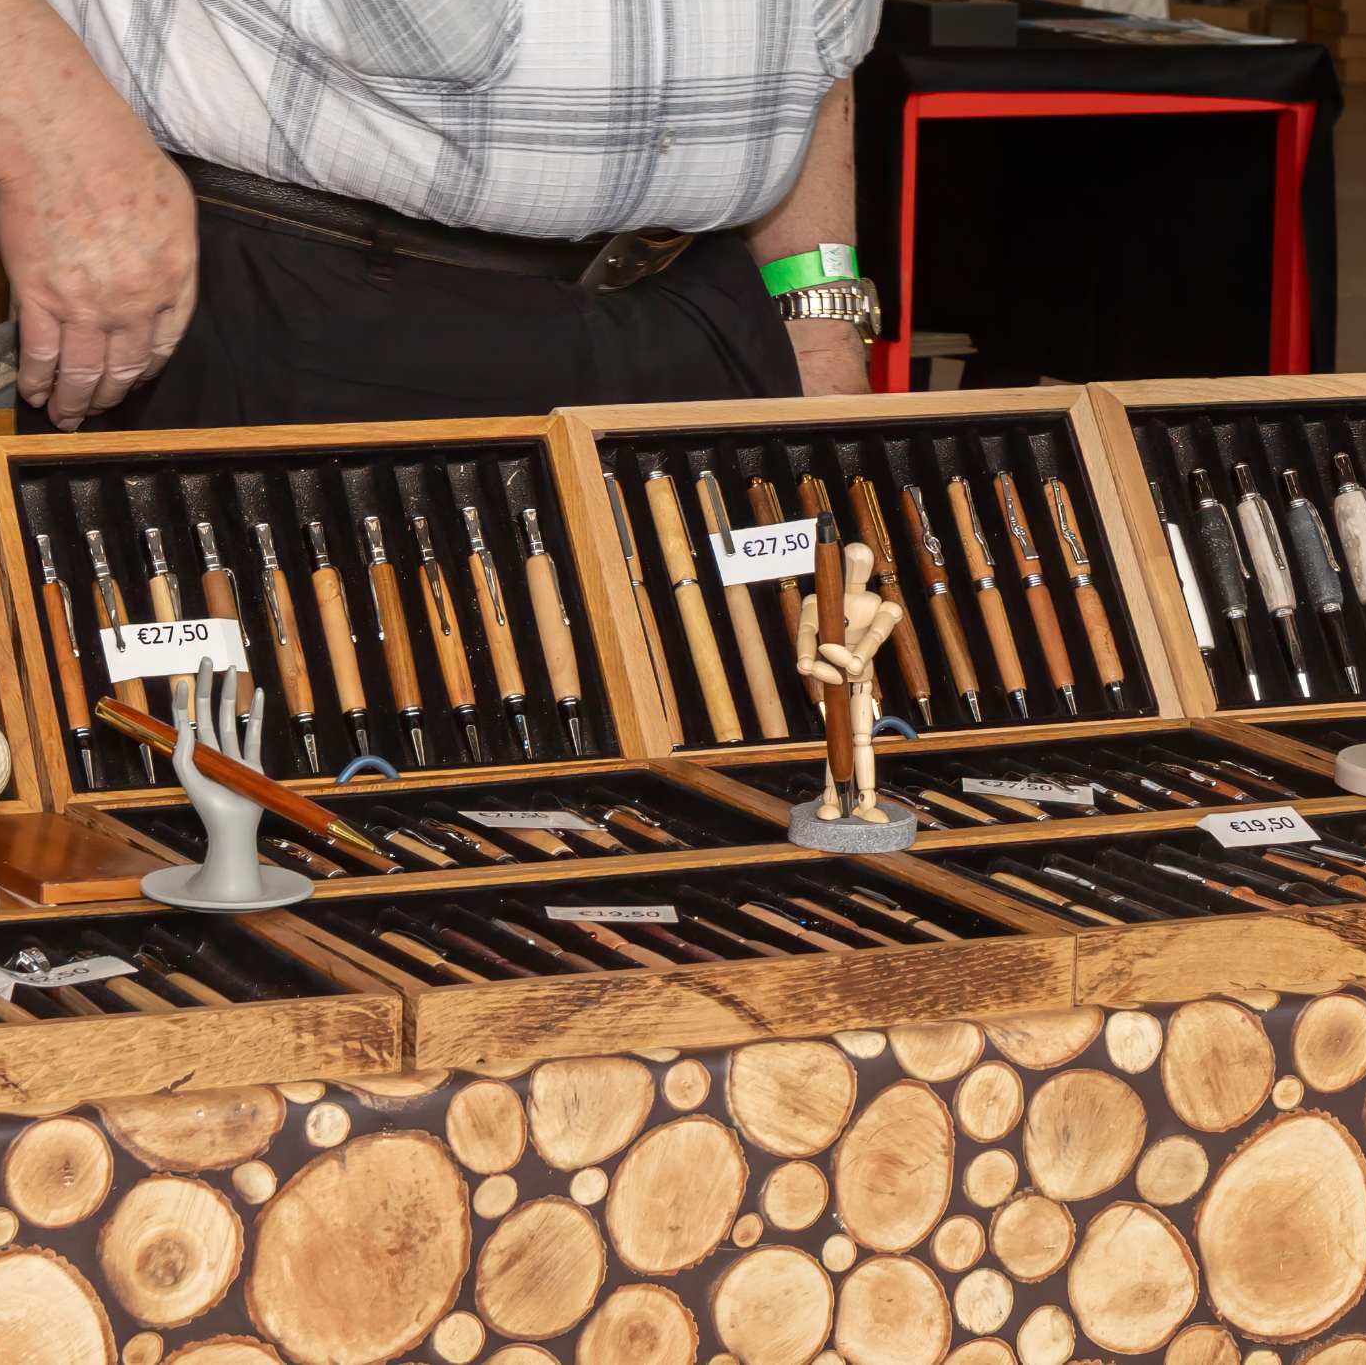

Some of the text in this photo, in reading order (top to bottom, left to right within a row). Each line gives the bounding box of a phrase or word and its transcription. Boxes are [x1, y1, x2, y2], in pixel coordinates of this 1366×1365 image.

[742, 533, 810, 557] €27,50
[137, 624, 209, 646] €27,50
[1230, 816, 1295, 833] €19,50
